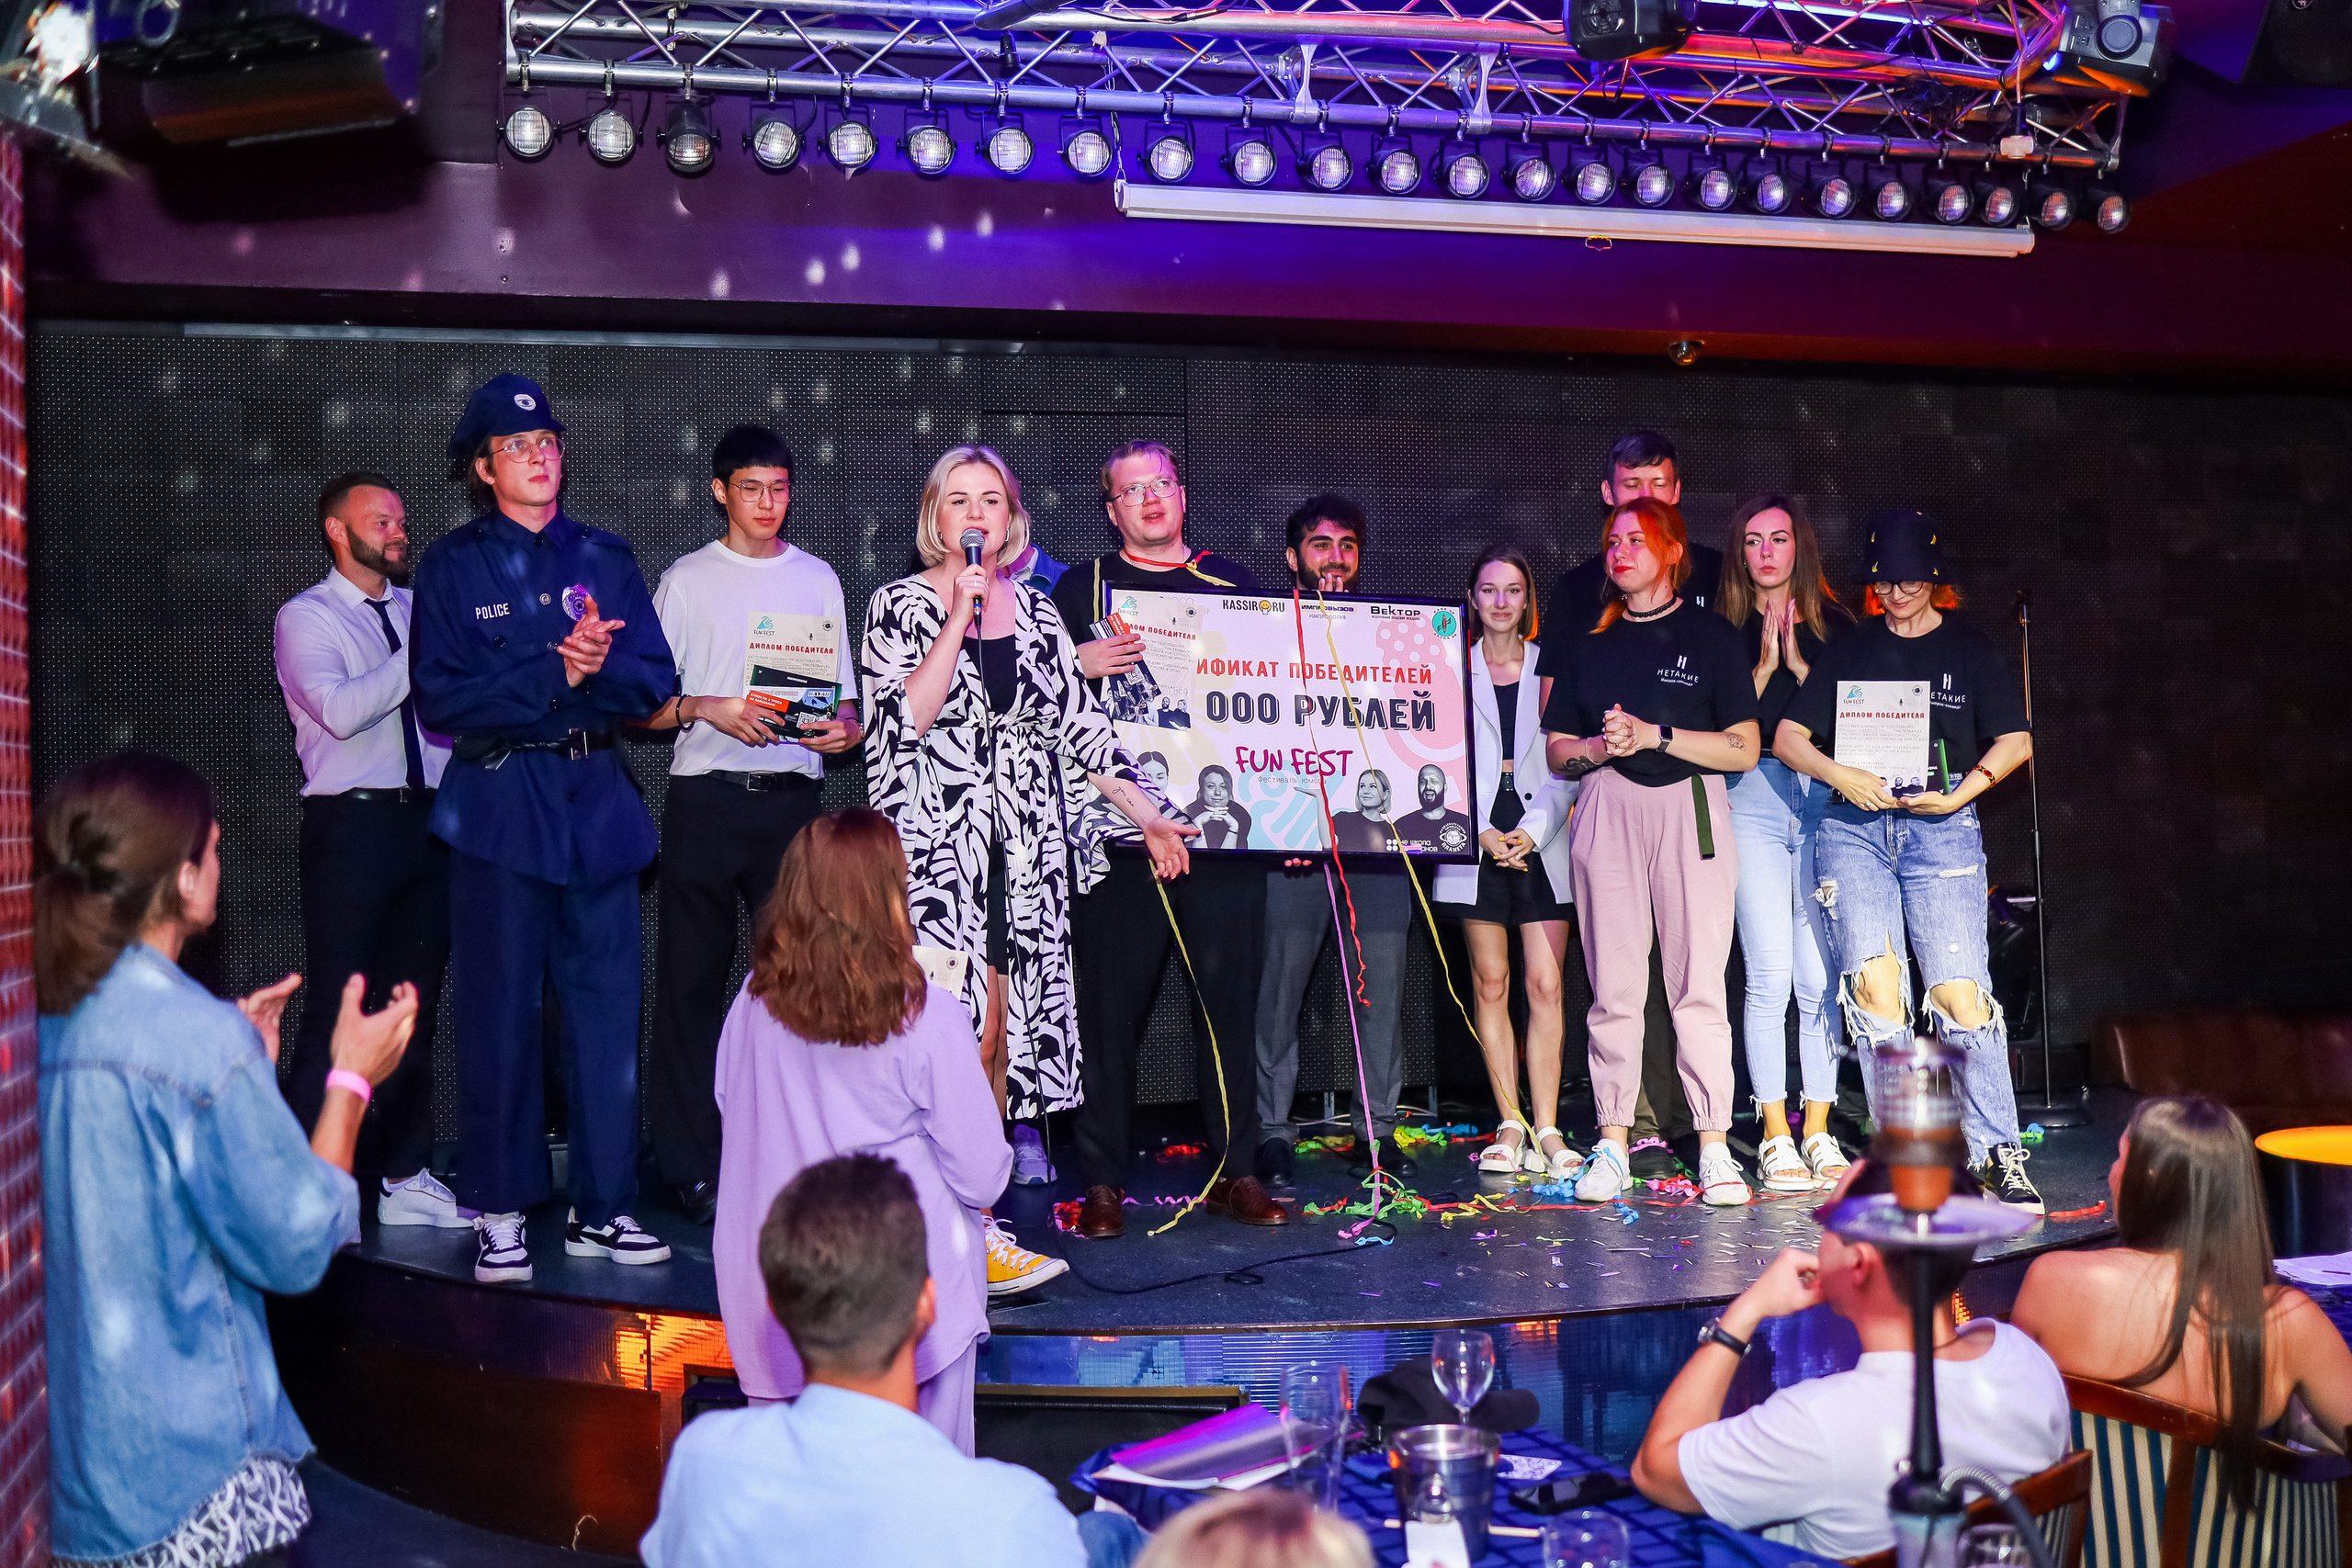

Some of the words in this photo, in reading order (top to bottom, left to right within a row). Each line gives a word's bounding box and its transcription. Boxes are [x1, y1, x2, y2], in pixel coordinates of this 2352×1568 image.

[475, 603, 511, 620] POLICE
[1148, 626, 1196, 640] ПОБЕДИТЕЛЯ
[749, 642, 782, 650] ДИПЛОМ
[785, 645, 833, 654] ПОБЕДИТЕЛЯ
[1197, 658, 1279, 678] ИФИКАТ
[1289, 662, 1432, 685] ПОБЕДИТЕЛЕЙ
[1657, 668, 1700, 683] НЕТАКИЕ
[1930, 692, 1966, 703] ЕТАКИЕ
[1206, 690, 1281, 726] 000
[1294, 690, 1436, 732] РУБЛЕЙ
[1235, 746, 1283, 774] FUN
[1291, 749, 1353, 777] FEST
